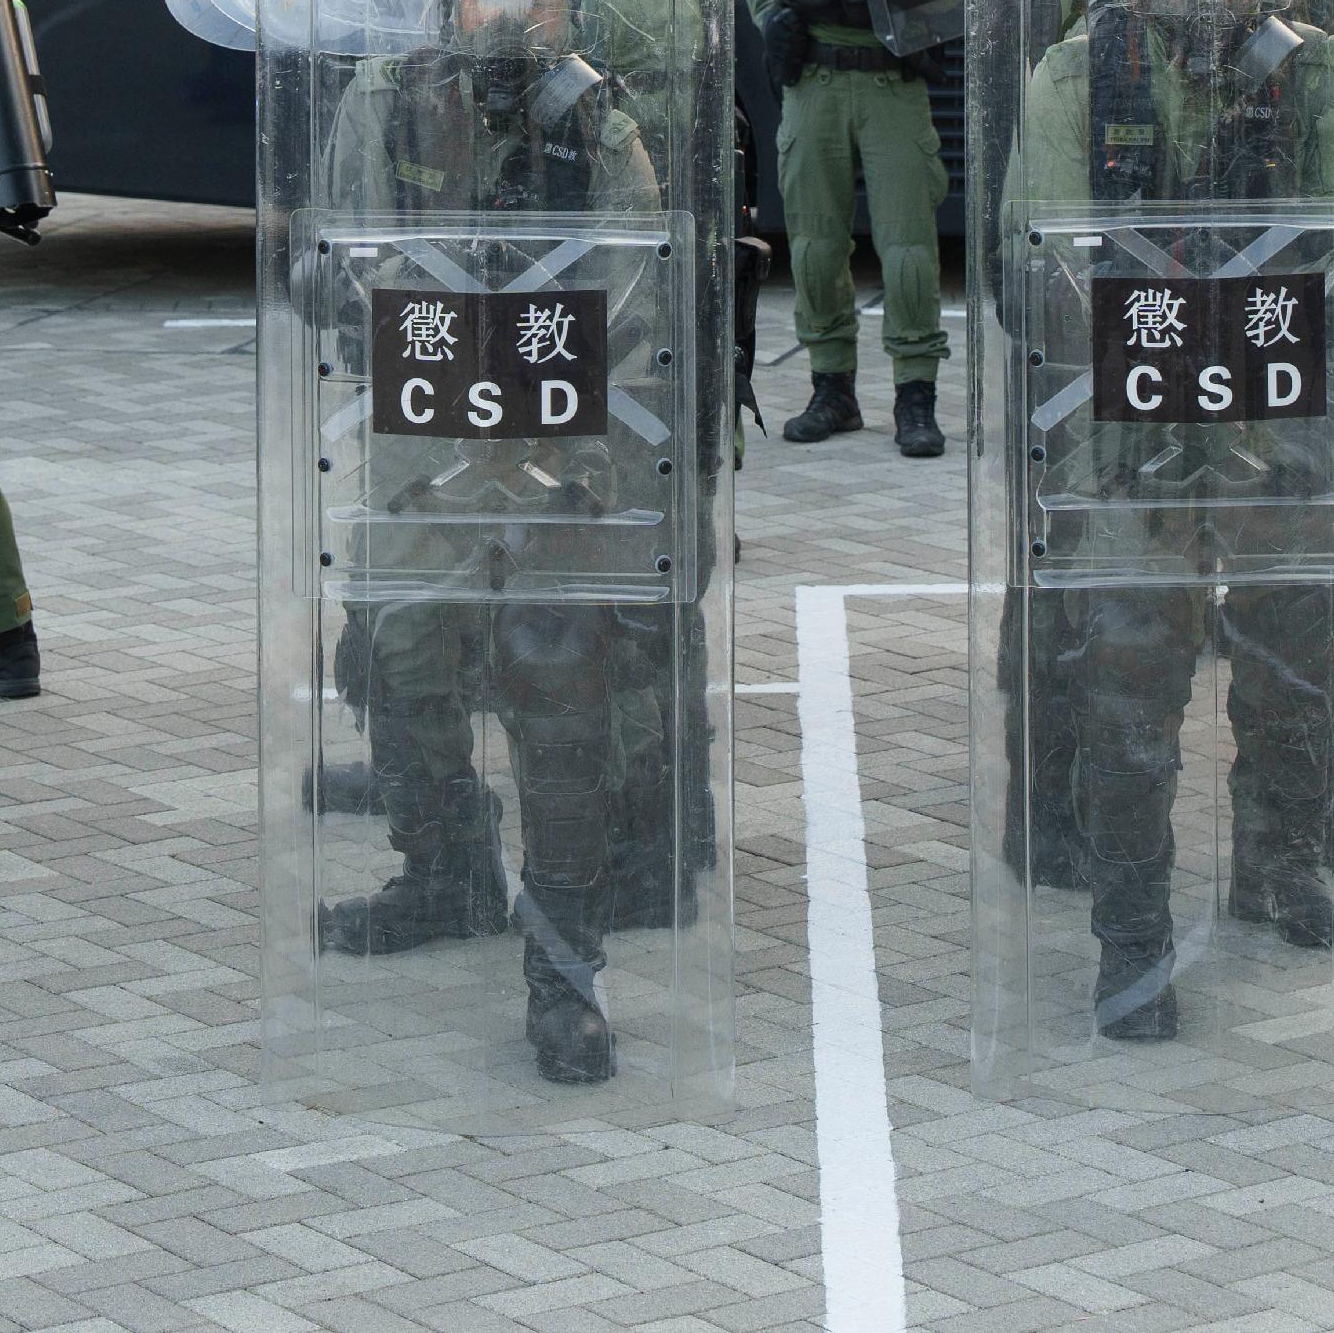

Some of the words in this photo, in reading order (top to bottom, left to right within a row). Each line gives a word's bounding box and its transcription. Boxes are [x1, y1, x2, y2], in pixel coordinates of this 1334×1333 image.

[398, 300, 578, 364] 懲教
[1123, 286, 1301, 348] 懲教
[400, 377, 579, 428] CSD
[1126, 362, 1302, 411] CSD
